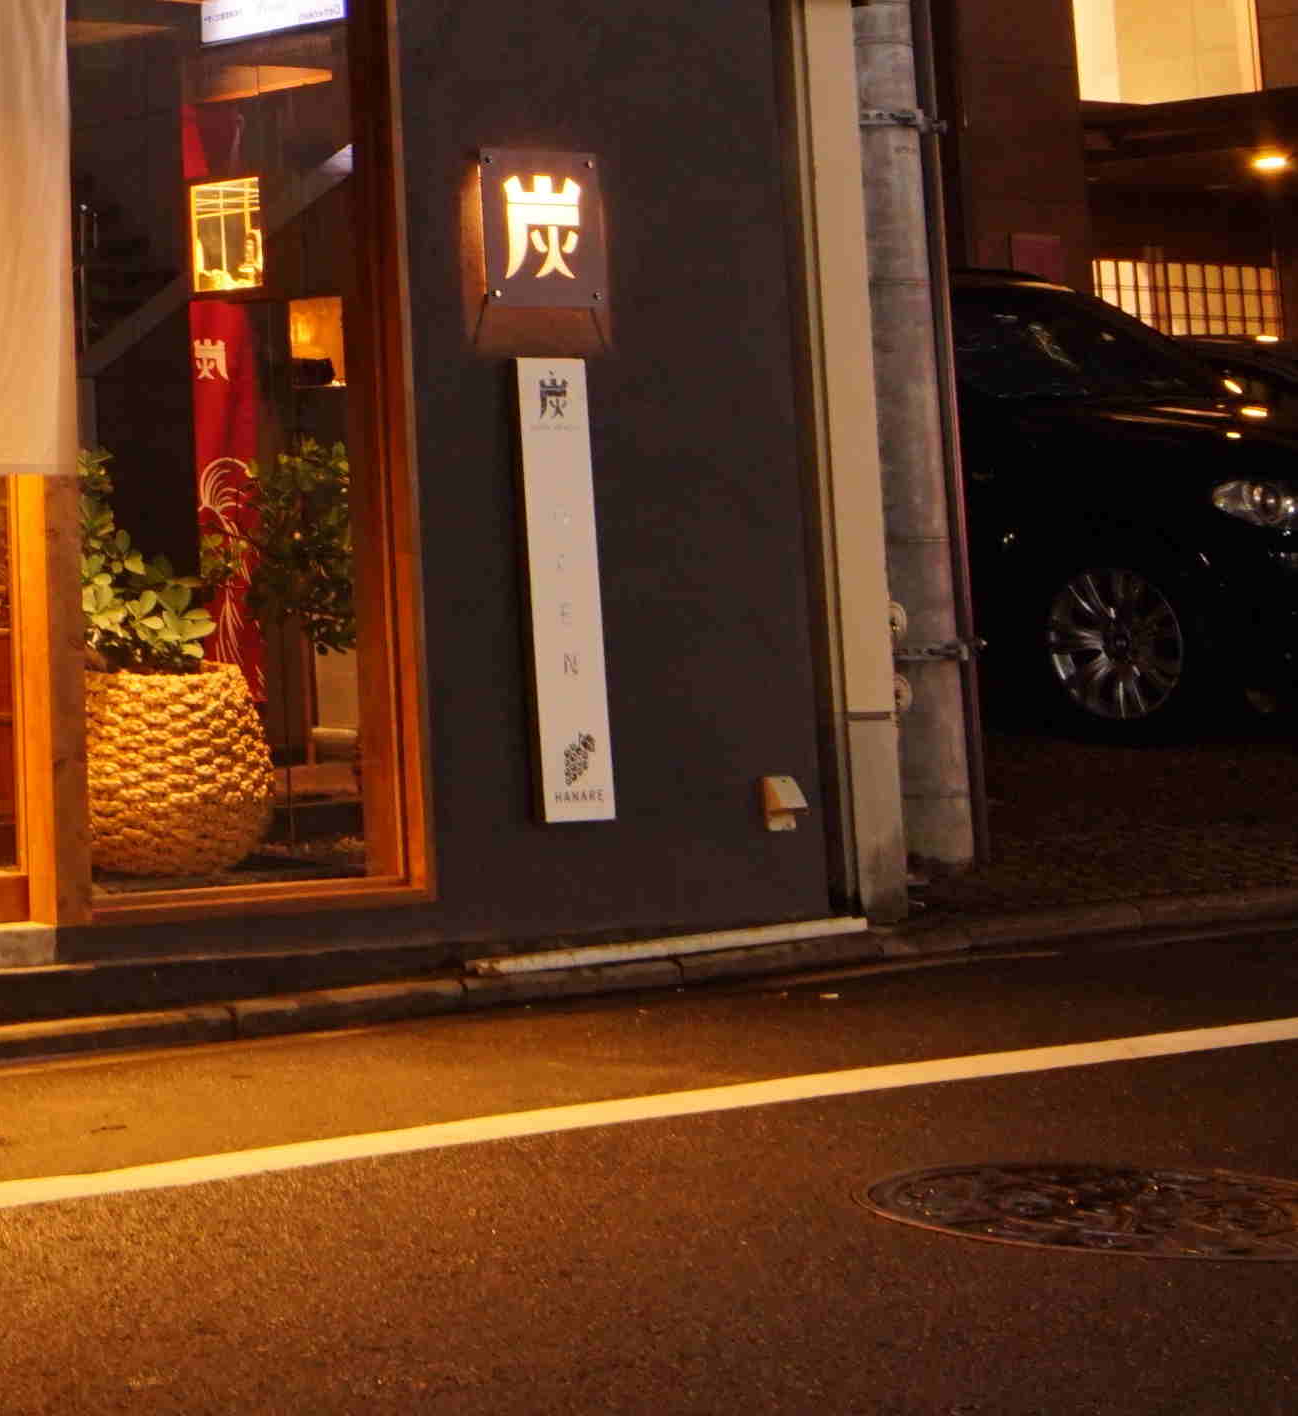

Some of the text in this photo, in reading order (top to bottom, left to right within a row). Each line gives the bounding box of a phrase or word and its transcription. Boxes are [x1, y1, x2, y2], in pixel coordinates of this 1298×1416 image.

[504, 174, 580, 279] 炭
[539, 377, 568, 418] 炭
[554, 789, 604, 803] HANARE
